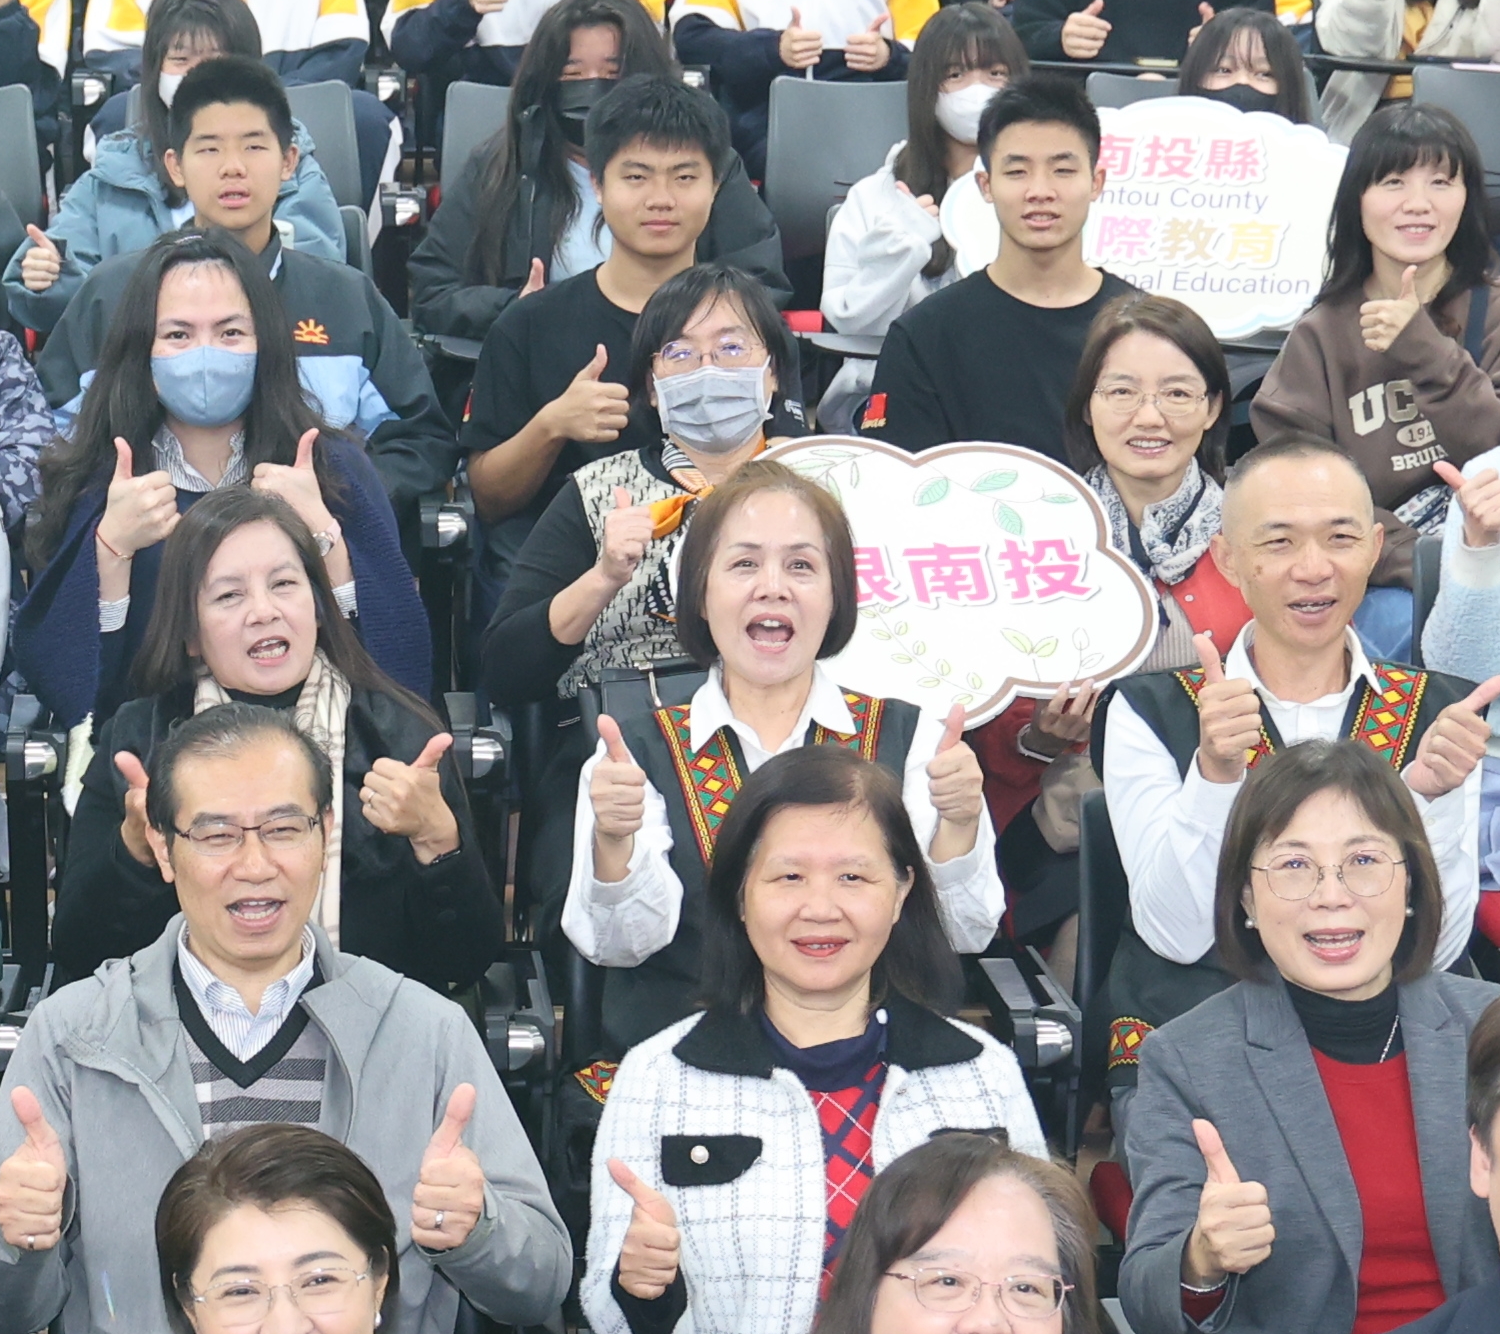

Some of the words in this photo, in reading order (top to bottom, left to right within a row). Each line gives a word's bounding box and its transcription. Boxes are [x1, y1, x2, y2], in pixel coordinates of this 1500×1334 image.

[1099, 188, 1159, 206] ntou
[1170, 188, 1269, 214] County
[1095, 216, 1282, 264] 際教育
[1173, 271, 1310, 294] Education
[1348, 379, 1420, 436] UC
[1408, 427, 1432, 442] 191
